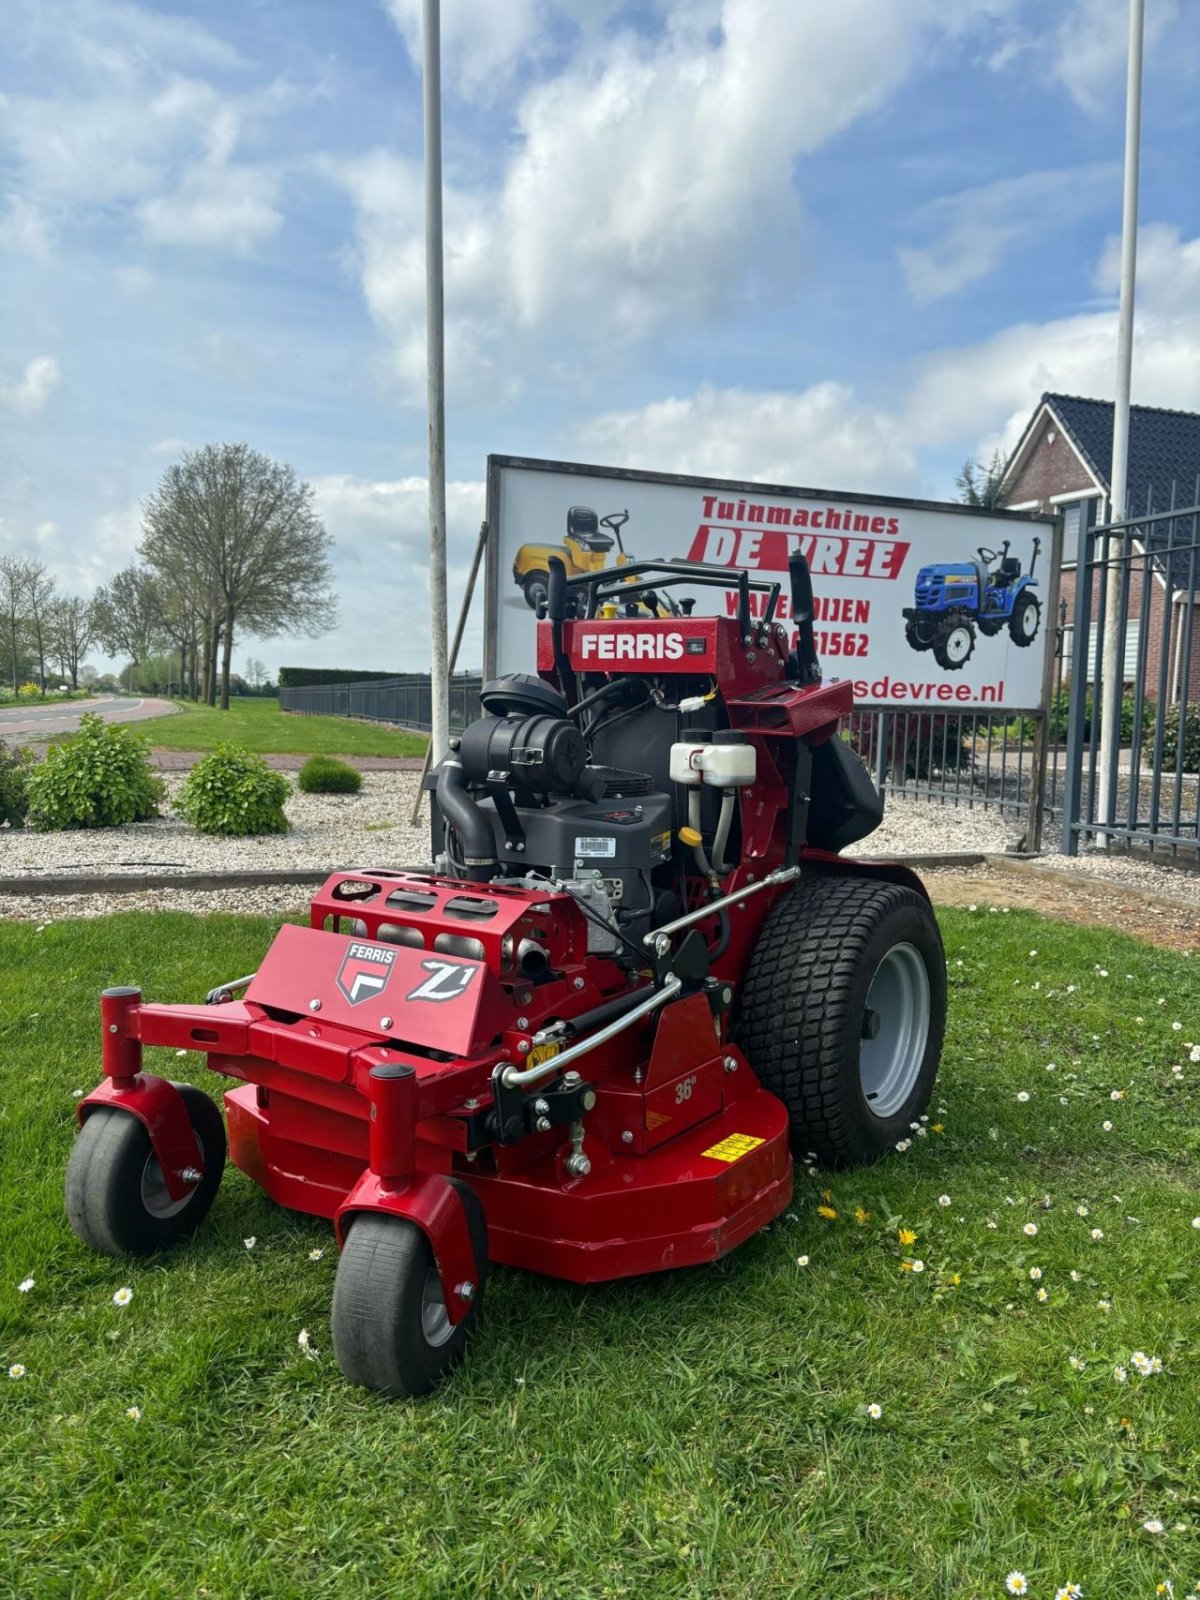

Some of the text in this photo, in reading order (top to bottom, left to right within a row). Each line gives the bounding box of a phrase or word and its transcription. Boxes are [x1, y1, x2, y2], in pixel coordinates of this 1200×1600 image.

[702, 496, 899, 535] Tuinmachines
[702, 527, 895, 578] DE VREE
[582, 633, 684, 660] FERRIS
[349, 944, 395, 964] FERRIS
